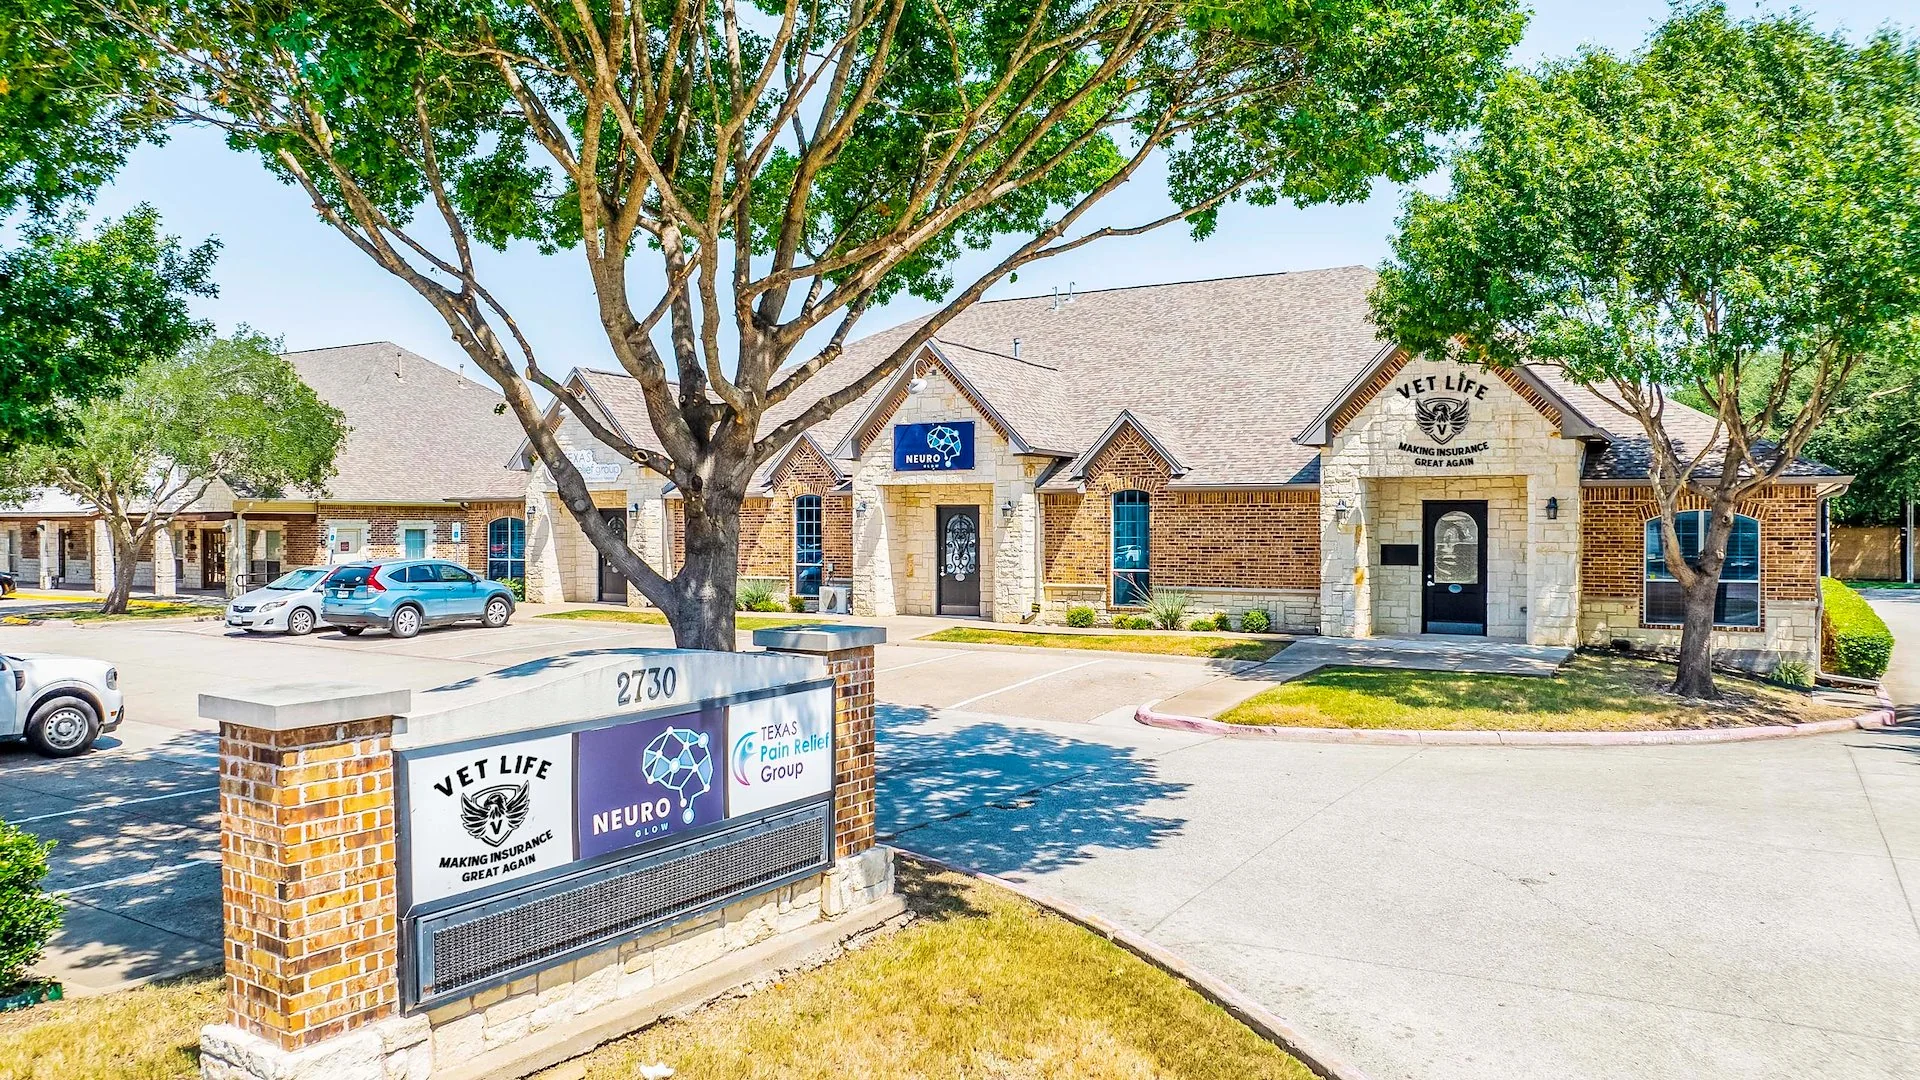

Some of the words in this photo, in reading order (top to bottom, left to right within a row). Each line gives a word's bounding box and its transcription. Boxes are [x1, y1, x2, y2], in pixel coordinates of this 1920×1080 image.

[1396, 375, 1436, 399] VET
[1445, 375, 1489, 401] LIFE
[906, 454, 941, 464] NEURO
[1398, 442, 1435, 456] MAKING
[1436, 441, 1489, 457] INSURANCE
[1414, 457, 1444, 468] GREAT
[1446, 457, 1474, 468] AGAIN
[617, 666, 676, 706] 2730
[761, 720, 798, 741] TEXAS
[760, 741, 789, 762] Pain
[794, 731, 830, 755] Relief
[433, 758, 488, 797] VET
[500, 755, 552, 780] LIFE
[760, 762, 804, 783] Group
[490, 819, 503, 834] V
[593, 797, 671, 836] NEURO
[635, 822, 669, 838] GLOW
[438, 854, 488, 868] MAKING
[490, 829, 553, 863] INSURANCE
[462, 866, 500, 882] GREAT
[502, 853, 536, 874] AGAIN
